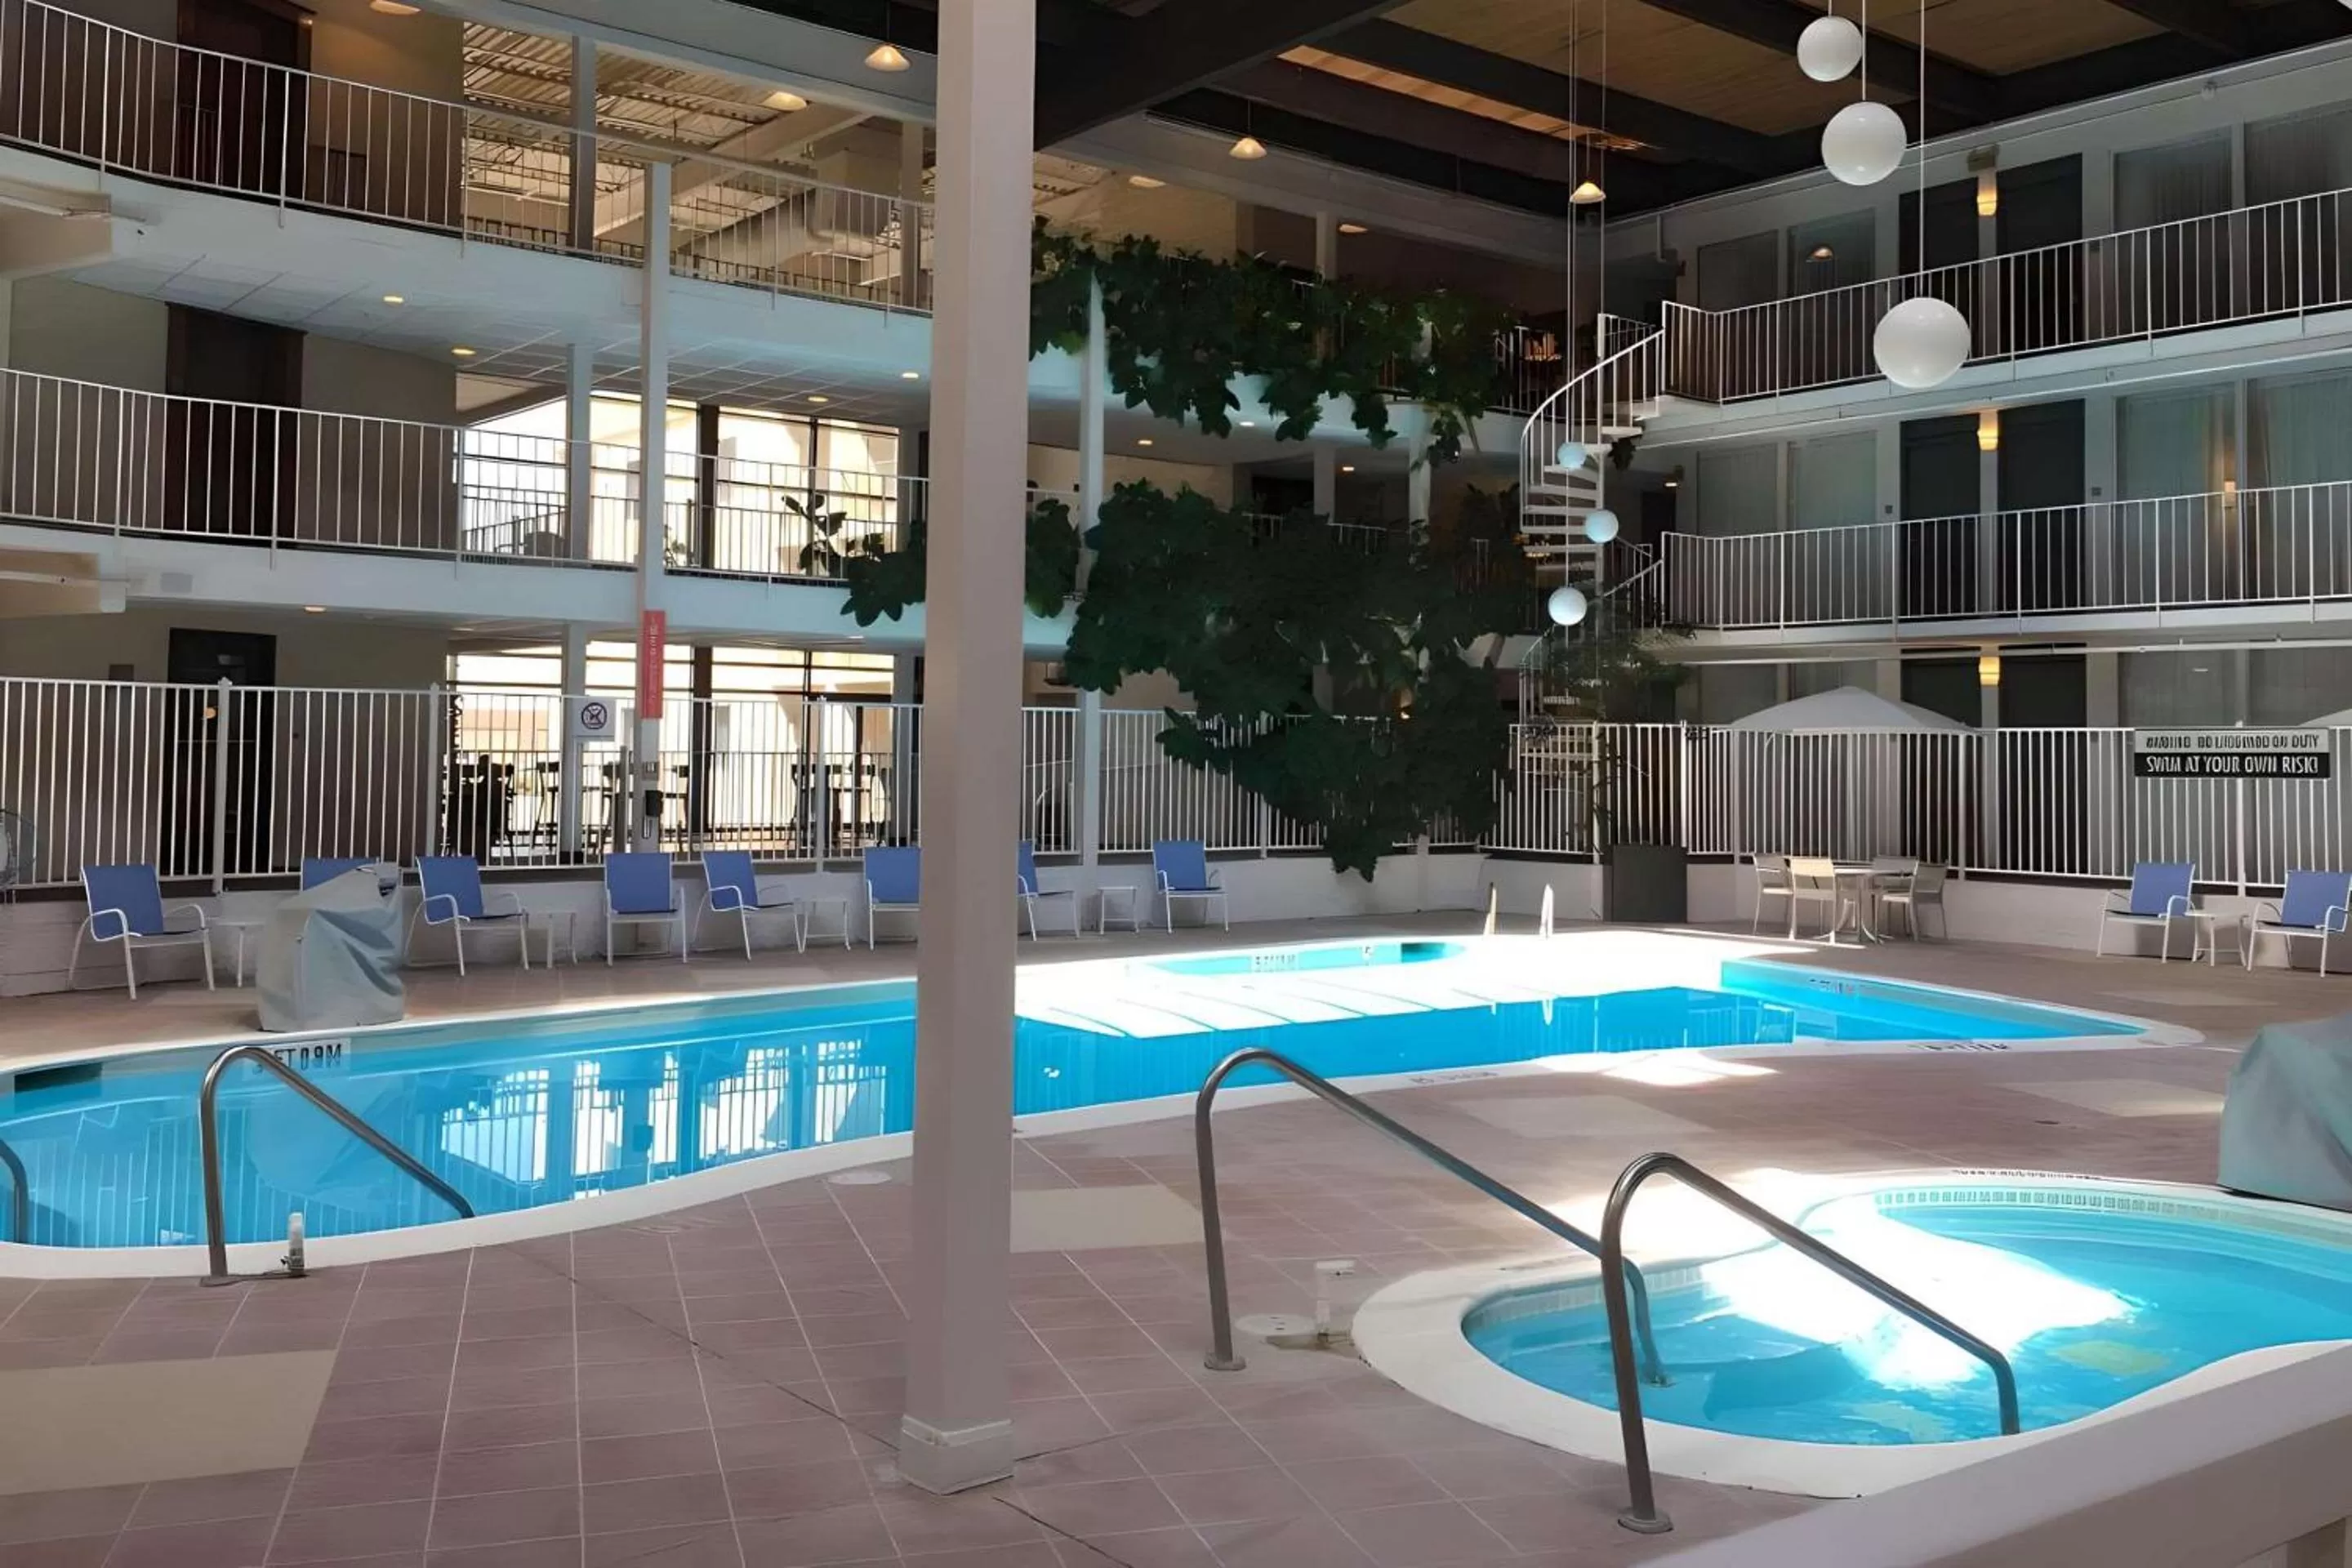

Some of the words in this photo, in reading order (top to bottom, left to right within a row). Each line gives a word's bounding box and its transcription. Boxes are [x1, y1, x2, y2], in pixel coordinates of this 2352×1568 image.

[2292, 734, 2319, 748] DUTY
[2146, 755, 2181, 773] SWIM
[2185, 756, 2200, 773] AT
[2203, 755, 2239, 773] YOUR
[2245, 756, 2277, 773] OWN
